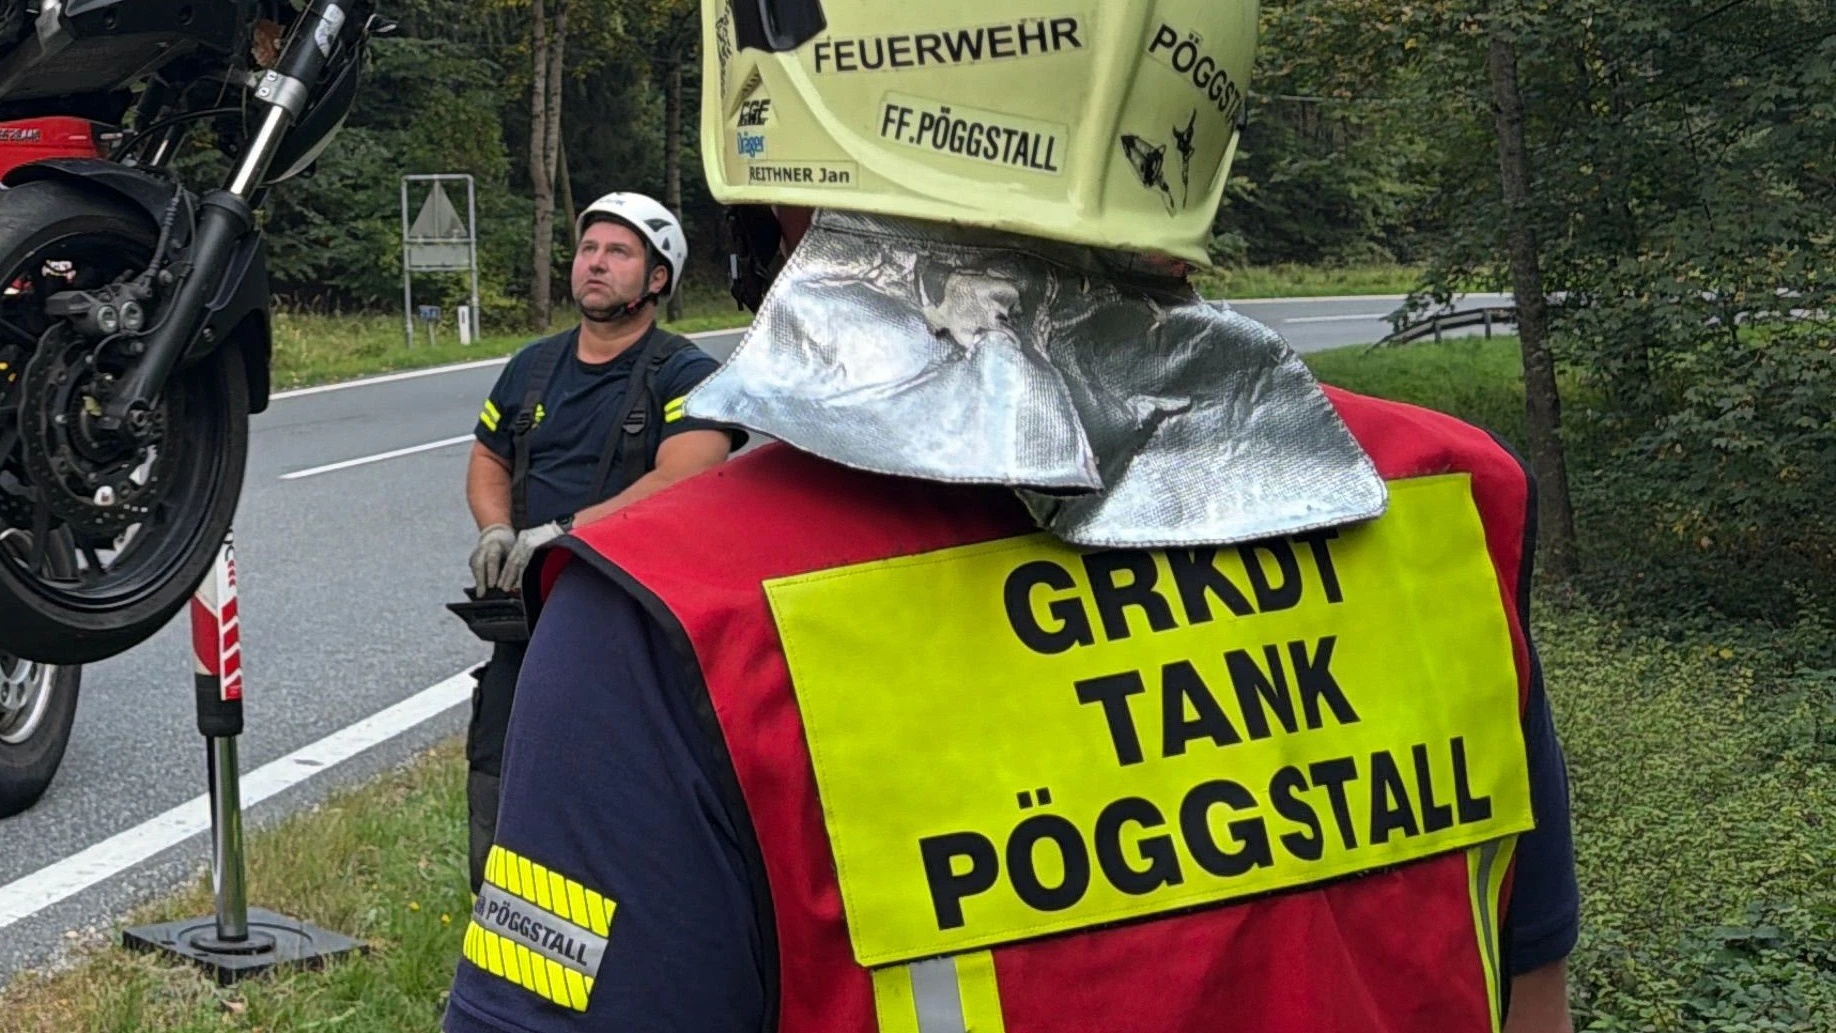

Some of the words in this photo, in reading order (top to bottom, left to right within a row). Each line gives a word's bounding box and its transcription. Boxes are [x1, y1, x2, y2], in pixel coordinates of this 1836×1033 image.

[813, 16, 1082, 73] FEUERWEHR
[880, 102, 1060, 172] FF.PÖGGSTALL
[748, 165, 813, 183] REITHNER
[819, 168, 850, 183] Jan
[1004, 531, 1344, 655] GRKDT
[1074, 635, 1361, 767] TANK
[919, 735, 1493, 931] PÖGGSTALL
[486, 899, 588, 967] PÖGGSTALL
